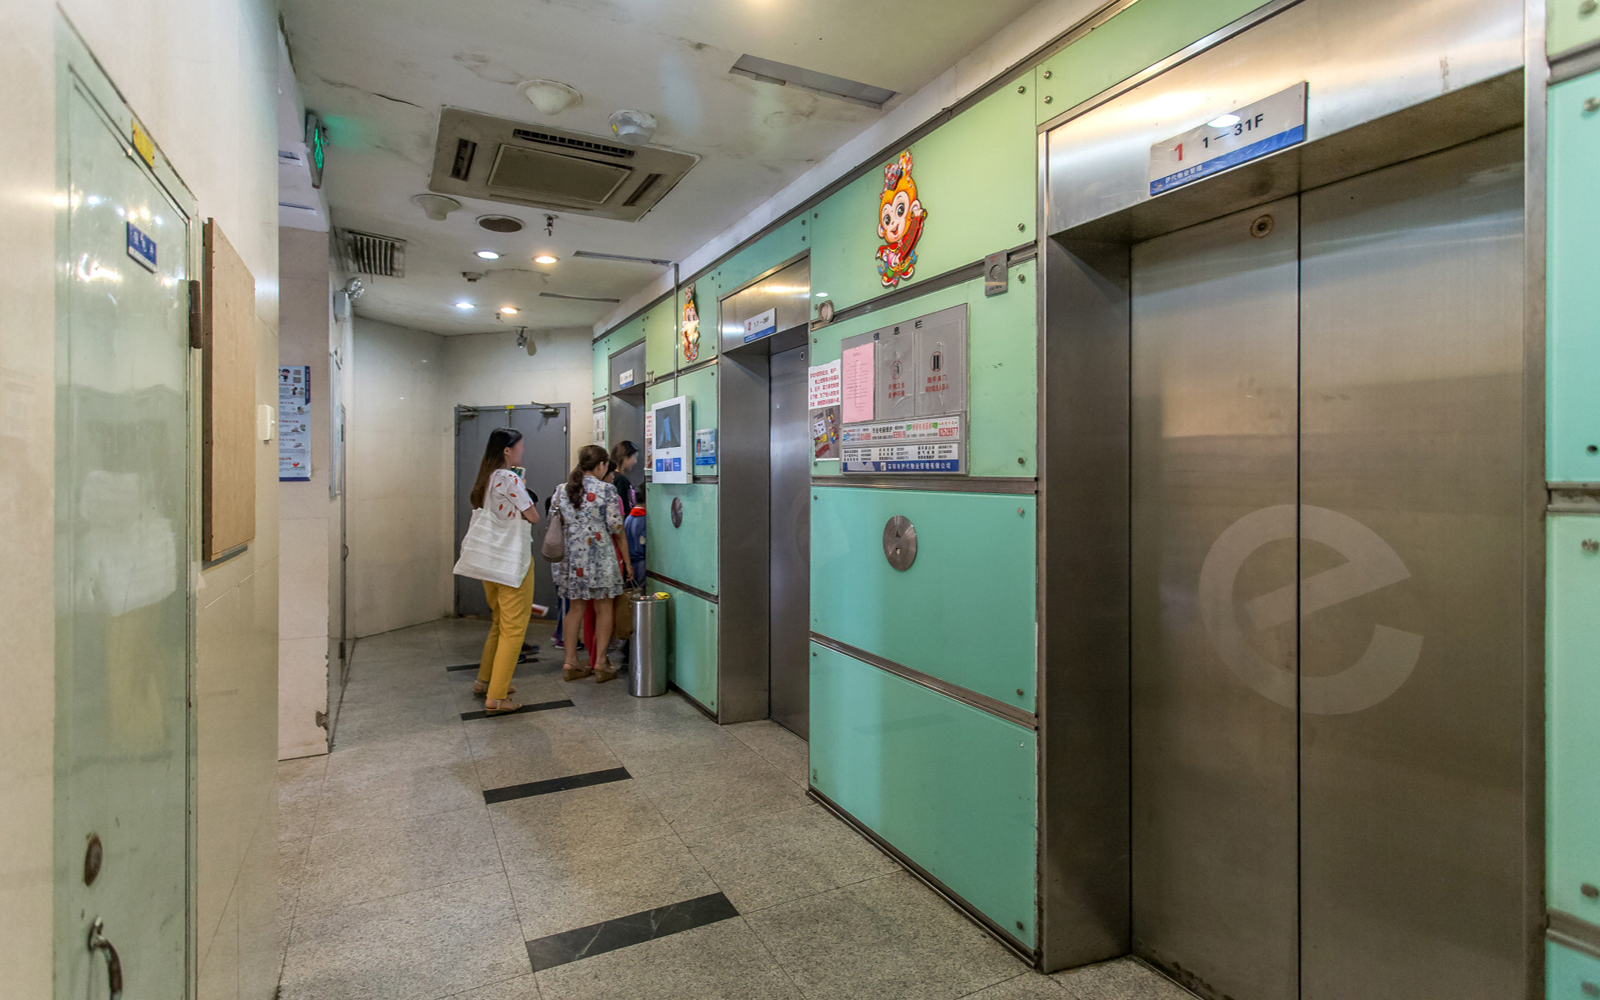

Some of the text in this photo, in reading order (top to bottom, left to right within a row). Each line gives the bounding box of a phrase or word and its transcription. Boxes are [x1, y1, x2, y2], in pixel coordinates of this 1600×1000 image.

[1174, 142, 1184, 161] 1
[747, 321, 752, 330] 2
[873, 320, 922, 341] 信息栏
